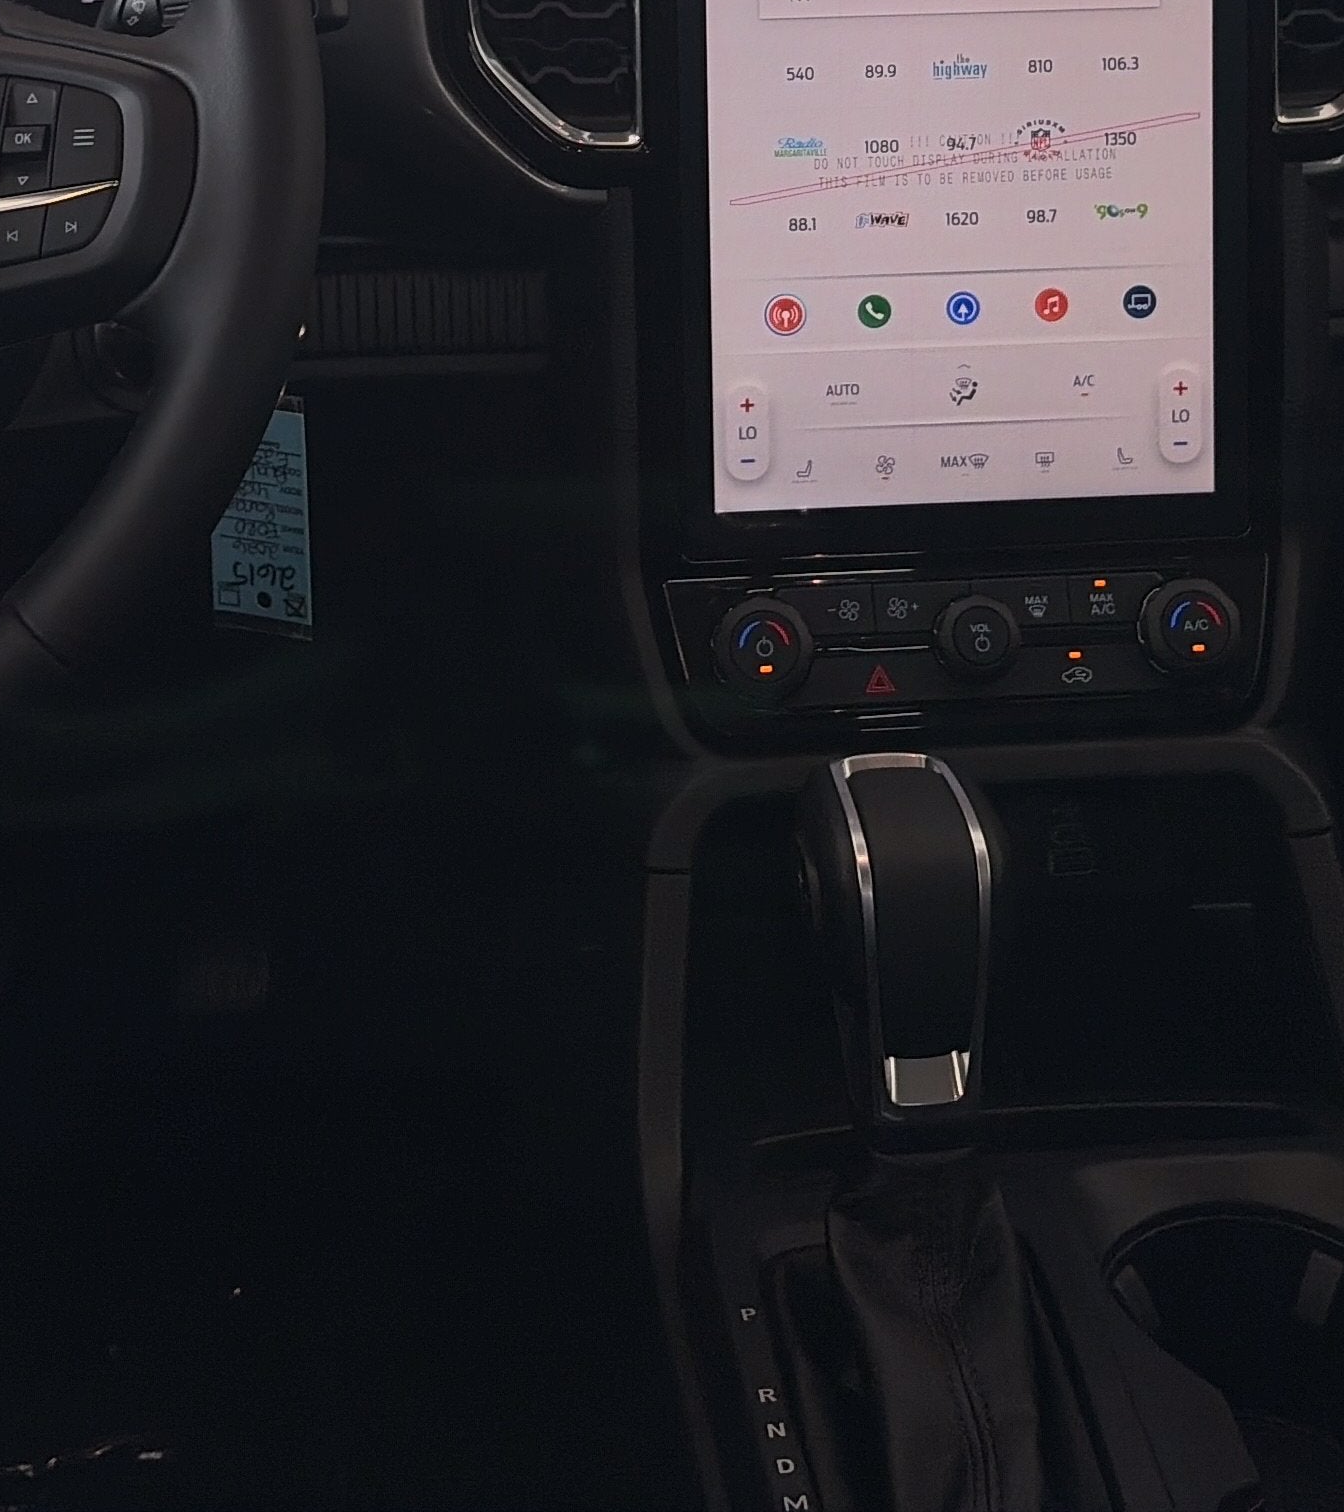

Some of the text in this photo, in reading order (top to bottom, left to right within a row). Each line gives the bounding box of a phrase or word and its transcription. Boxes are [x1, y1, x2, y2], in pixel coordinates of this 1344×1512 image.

[957, 53, 970, 63] the
[1102, 56, 1139, 72] 106.3
[786, 67, 815, 81] 540
[864, 64, 897, 78] 89.9
[932, 60, 988, 80] highway
[1028, 59, 1053, 74] 810
[13, 131, 32, 144] OK
[946, 136, 977, 151] 94.7
[1104, 131, 1137, 146] 1350
[864, 139, 899, 154] 1080
[814, 157, 828, 170] DO
[836, 156, 858, 169] NOT
[868, 155, 905, 168] TOUCH
[912, 153, 964, 167] DISPLAY
[973, 150, 1018, 164] DURING
[818, 167, 1113, 189] THIS FILM IS TO BE REMOVED BEFORE USAGE
[945, 211, 979, 226] 1620
[1026, 209, 1057, 224] 98.7
[788, 217, 816, 232] 88.1
[1073, 375, 1095, 388] A/C
[825, 384, 860, 397] AUTO
[1171, 408, 1190, 423] LO
[738, 426, 757, 440] LO
[940, 455, 967, 469] MAX
[233, 562, 296, 591] 2615
[1025, 596, 1049, 605] MAX
[1090, 594, 1114, 603] MAX
[1091, 603, 1116, 615] A/C
[970, 624, 992, 633] VOL
[1184, 620, 1209, 631] A/C
[740, 1308, 756, 1321] P
[758, 1388, 777, 1403] R
[767, 1422, 786, 1438] N
[776, 1458, 795, 1474] D
[783, 1495, 808, 1512] M
